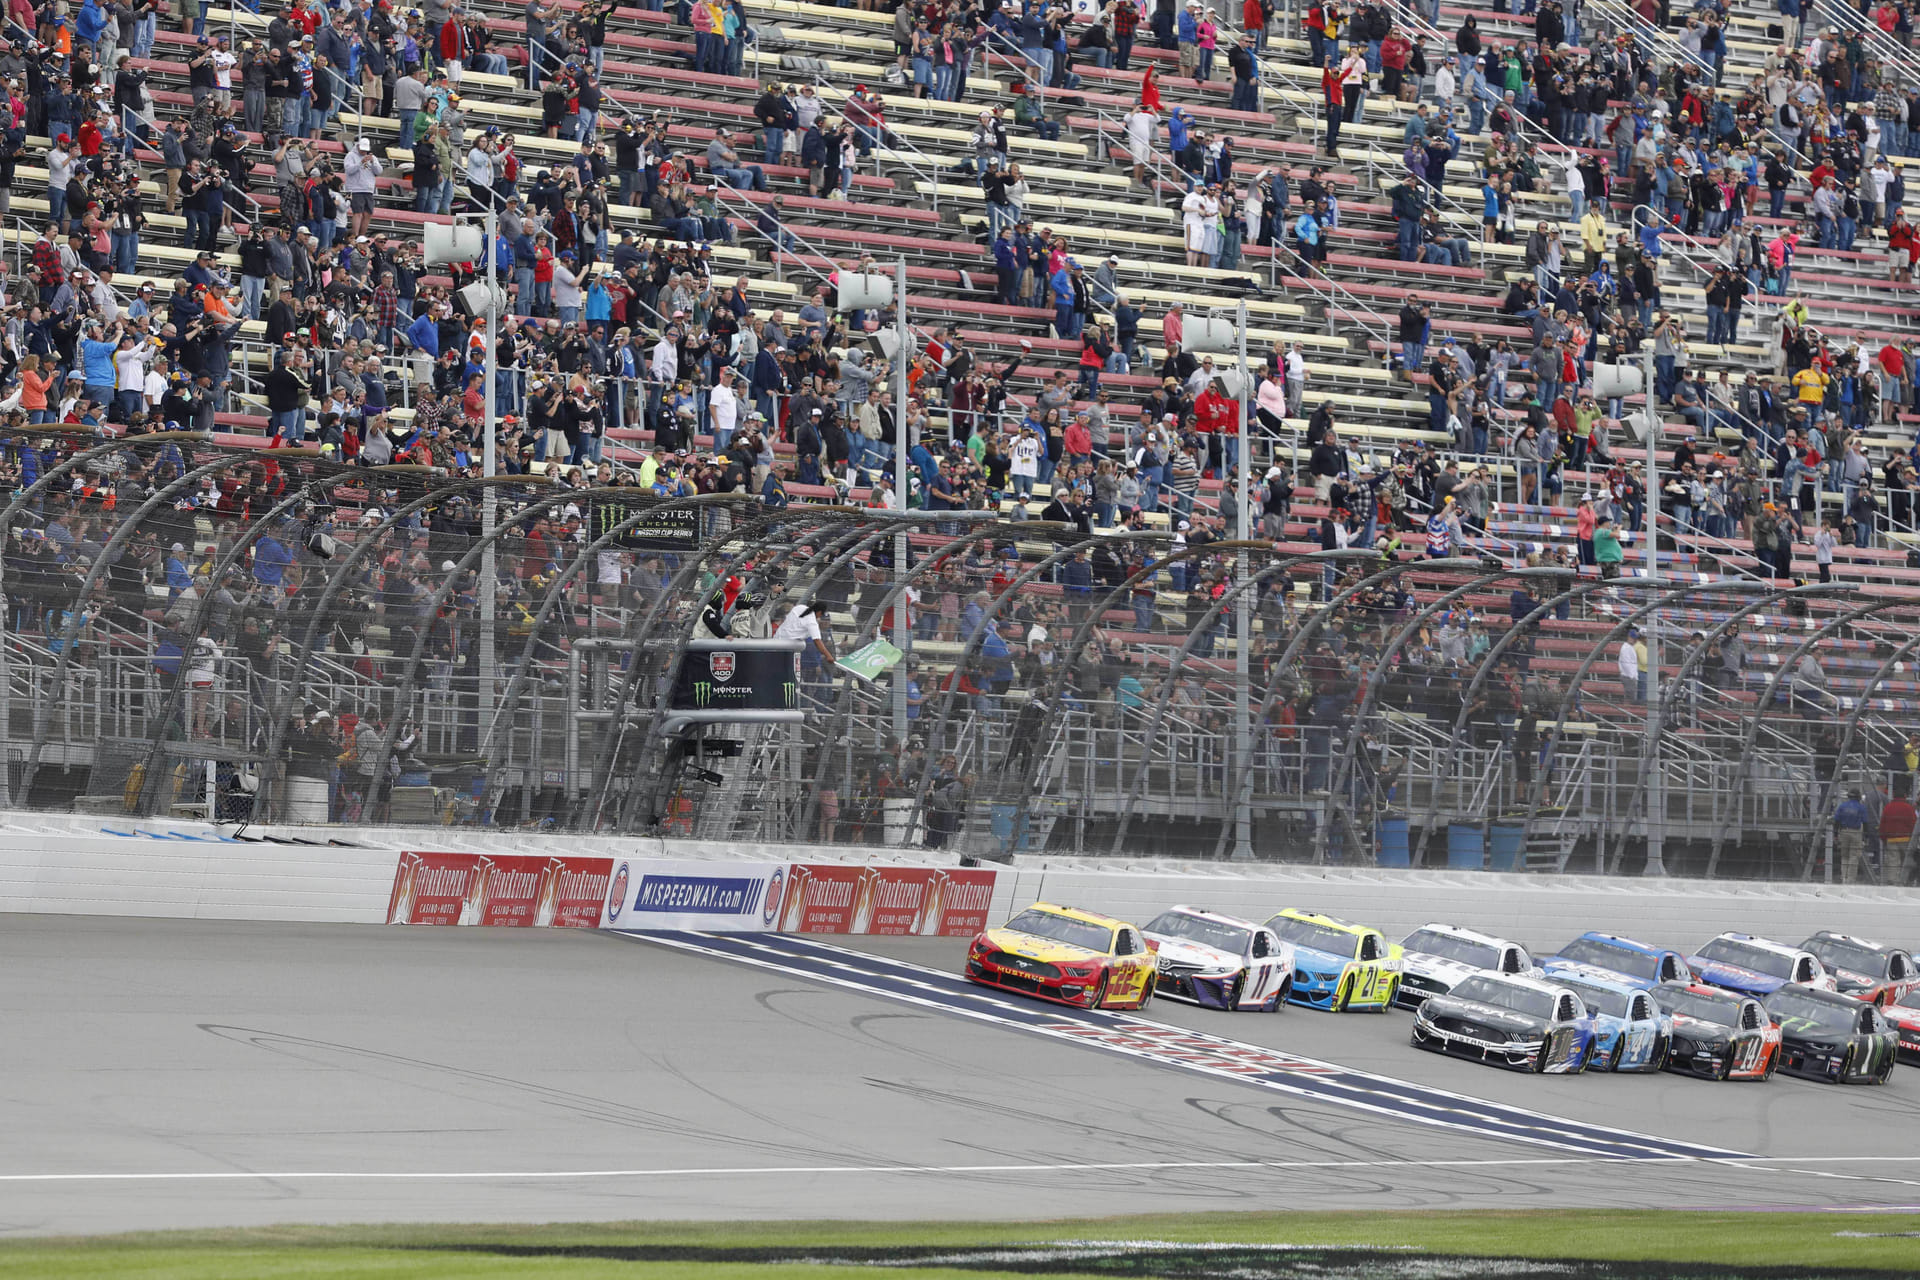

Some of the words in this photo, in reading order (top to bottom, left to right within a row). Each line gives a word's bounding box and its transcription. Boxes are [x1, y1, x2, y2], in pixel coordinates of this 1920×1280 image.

[630, 509, 695, 520] MSTER
[713, 686, 752, 694] MONSTER
[641, 883, 742, 908] MISPEEDWAY.com
[1111, 960, 1137, 995] 22
[1251, 964, 1272, 1000] 11
[1361, 966, 1379, 998] 21
[1443, 1032, 1491, 1048] MUSTANG
[1630, 1029, 1647, 1062] 4
